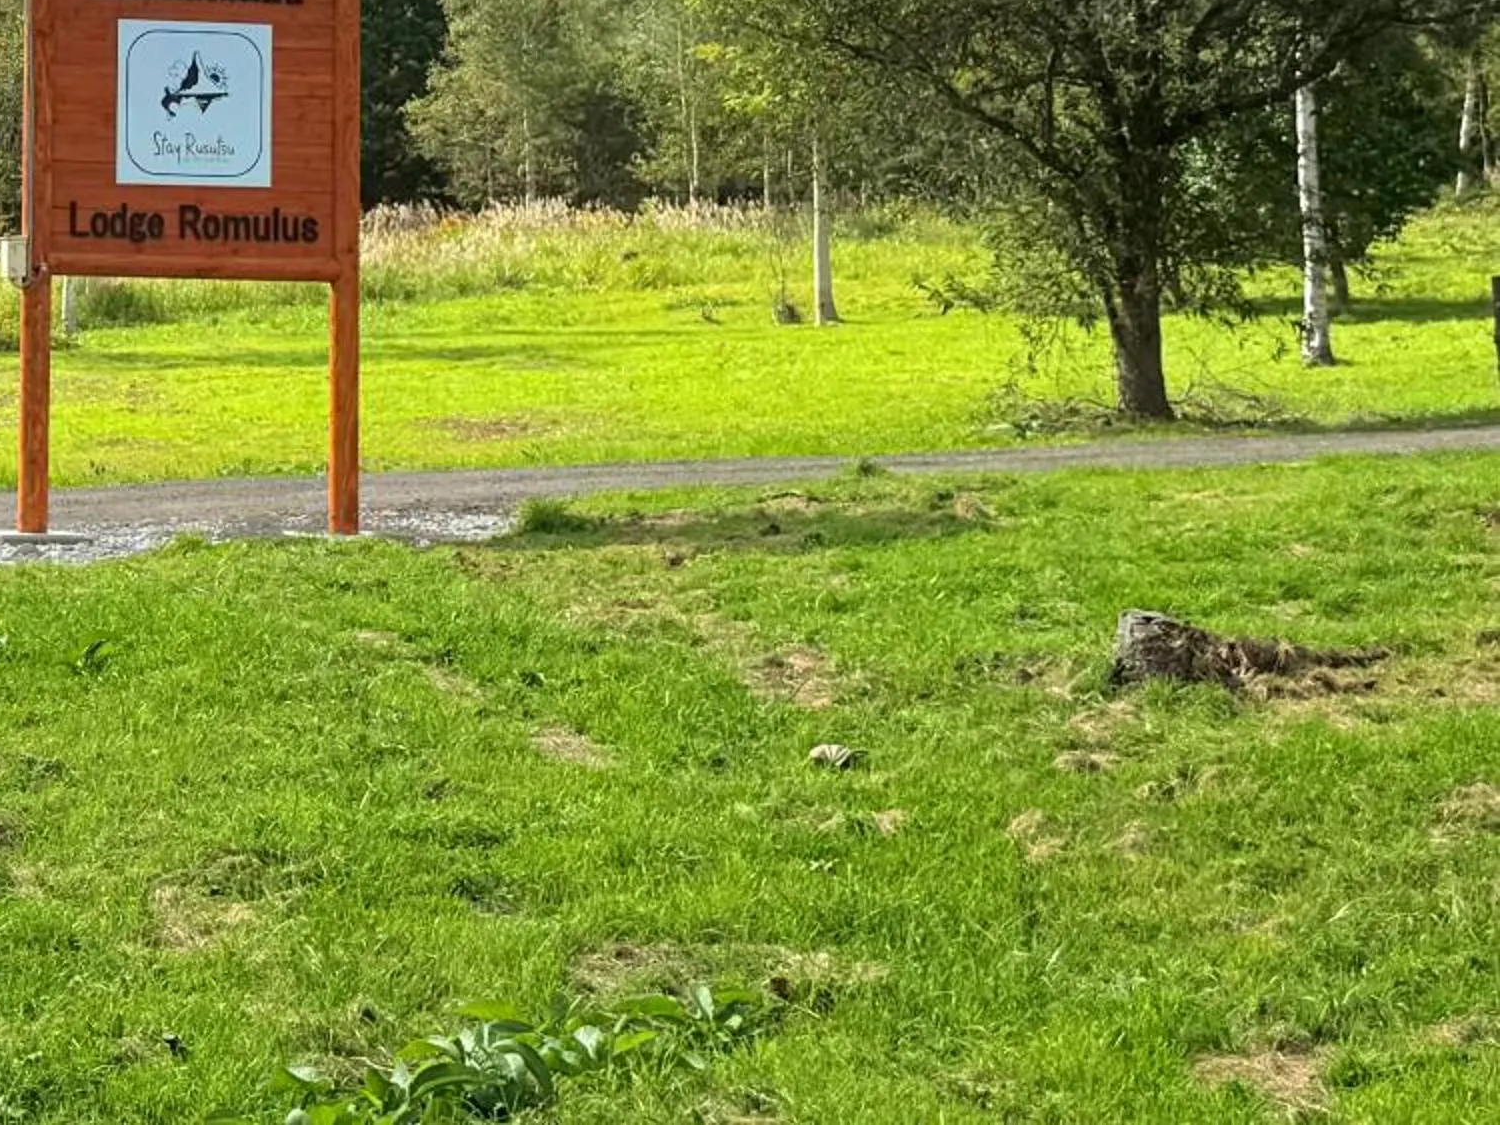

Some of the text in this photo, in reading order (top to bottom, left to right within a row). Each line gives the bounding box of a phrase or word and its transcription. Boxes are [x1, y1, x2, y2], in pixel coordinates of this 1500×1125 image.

[152, 130, 236, 164] Stay Rusutsu
[69, 201, 319, 244] Lodge Romulus
